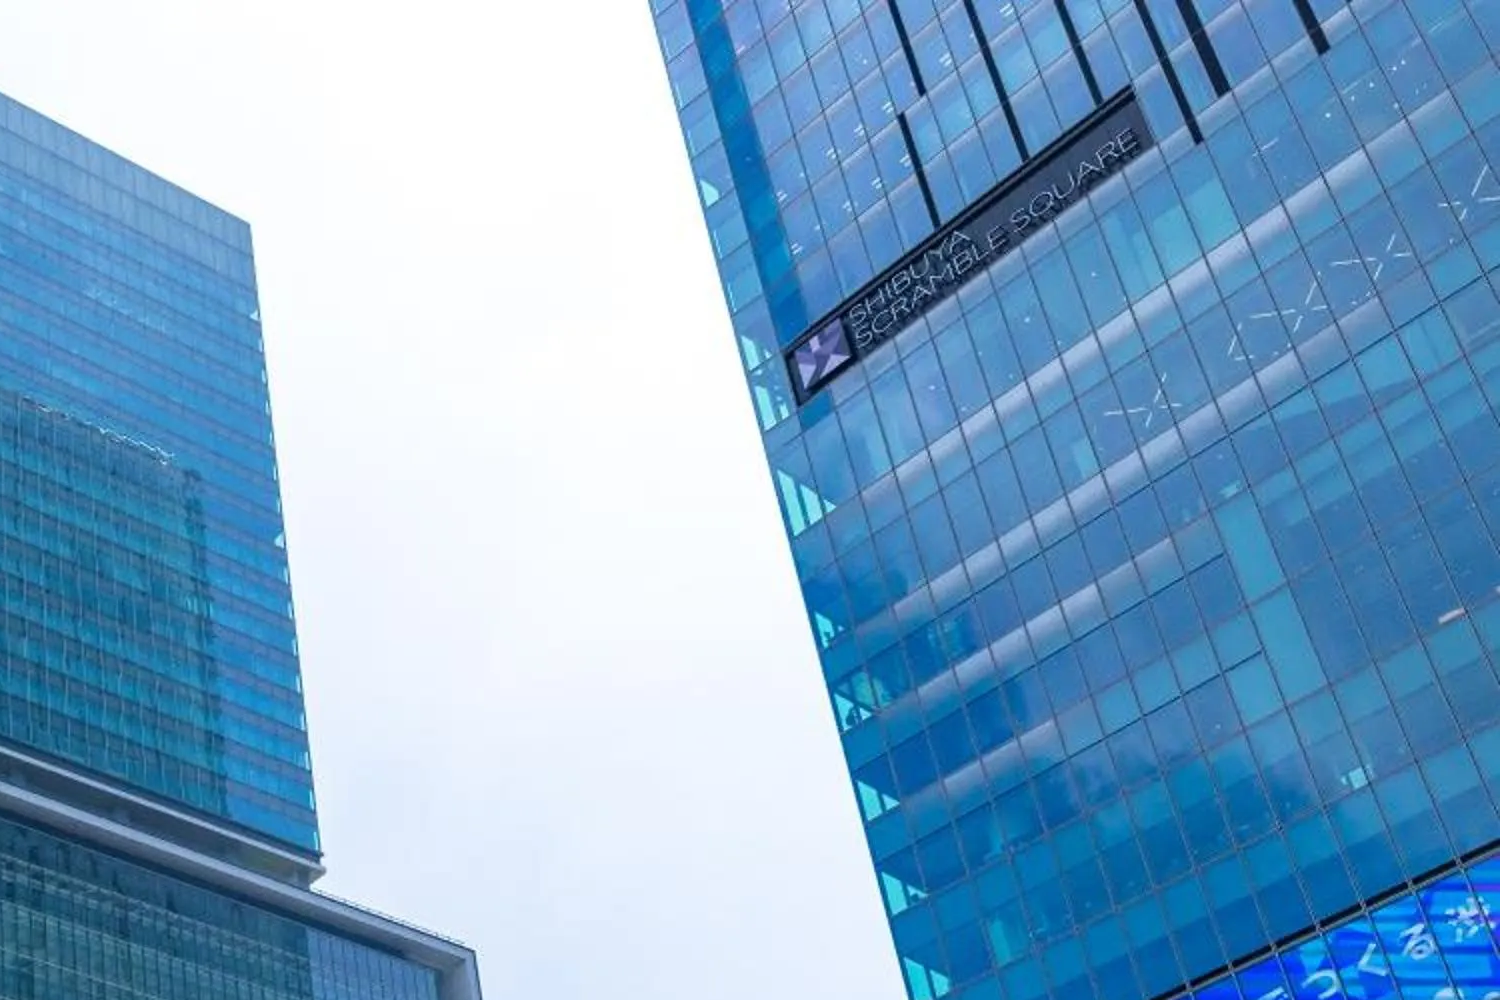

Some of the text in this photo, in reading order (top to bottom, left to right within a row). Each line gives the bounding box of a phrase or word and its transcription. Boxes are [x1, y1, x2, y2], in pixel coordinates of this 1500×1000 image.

[849, 230, 971, 329] SHIBUYA
[855, 127, 1138, 349] SCRAMBLE SQUARE
